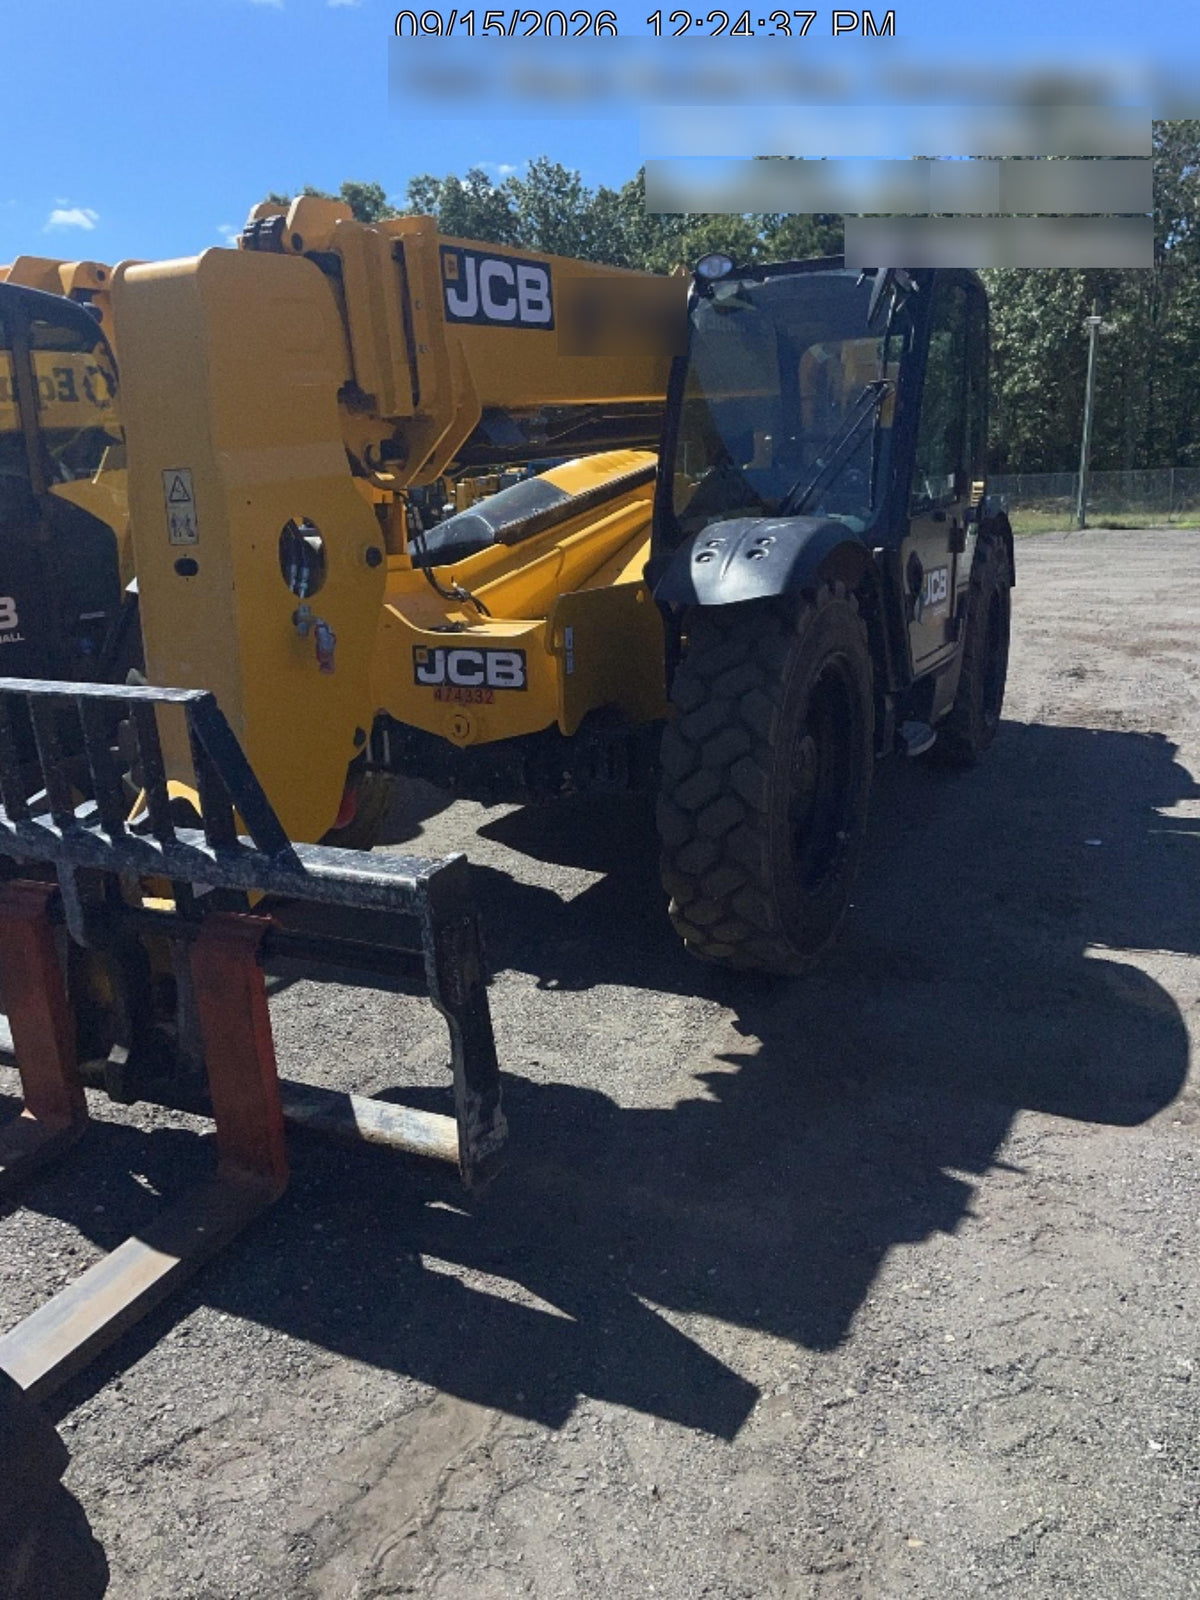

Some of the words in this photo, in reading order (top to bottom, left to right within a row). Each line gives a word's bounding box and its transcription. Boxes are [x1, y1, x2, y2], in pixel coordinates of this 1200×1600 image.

[446, 256, 552, 323] JCB
[923, 568, 947, 606] JCB
[417, 649, 525, 687] JCB
